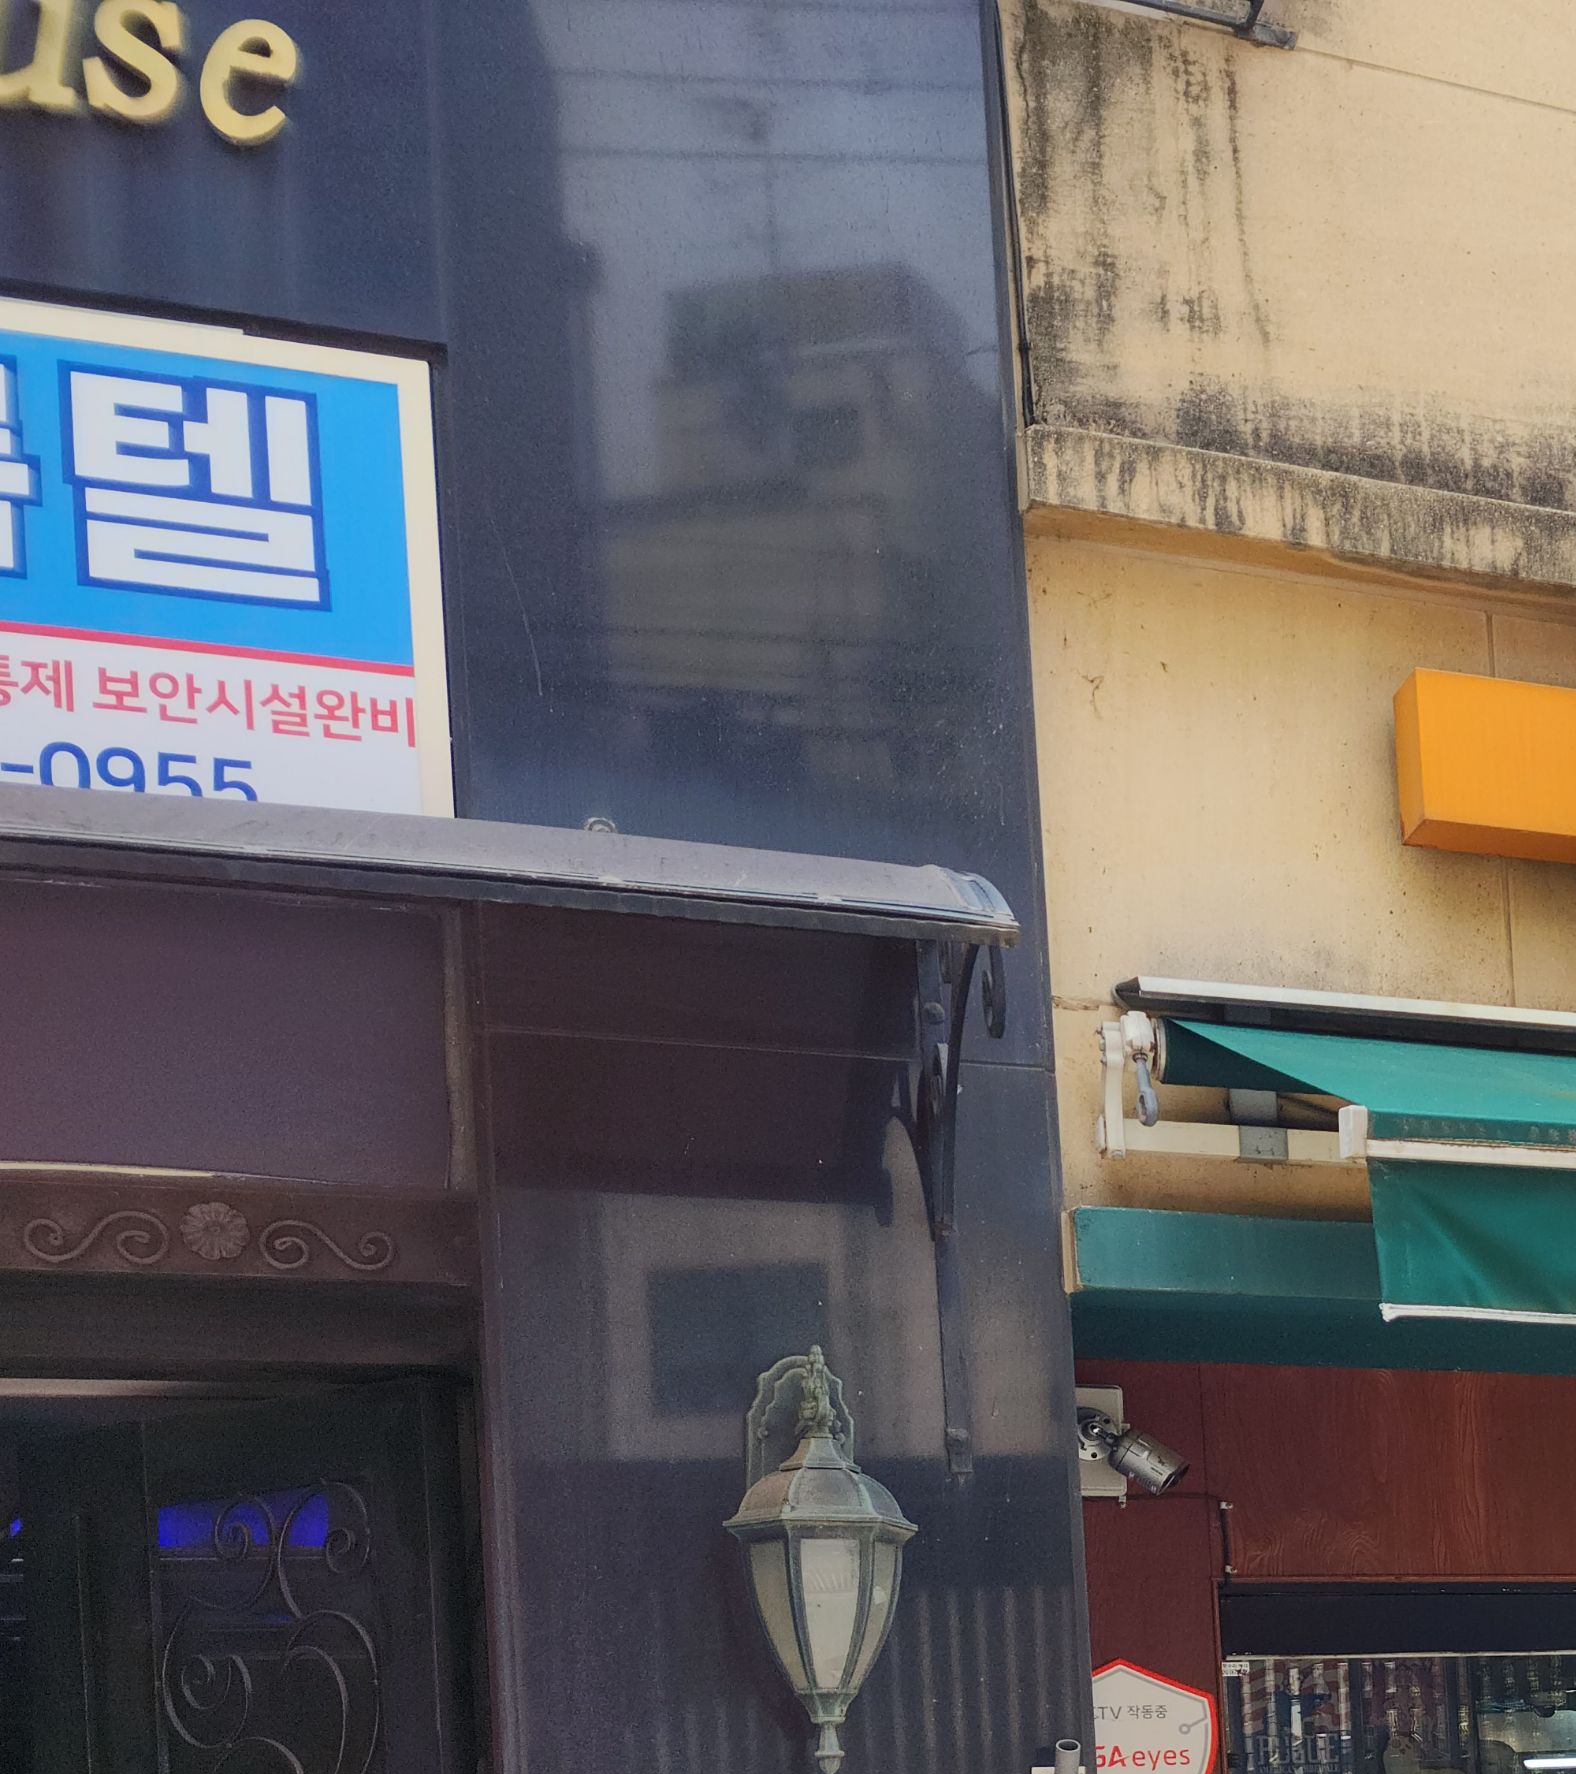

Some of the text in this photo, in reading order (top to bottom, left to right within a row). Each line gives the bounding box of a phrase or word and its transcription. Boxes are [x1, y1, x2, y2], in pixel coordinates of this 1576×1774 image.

[92, 666, 417, 748] 보안시설완비
[1127, 1704, 1168, 1720] 작동중
[1131, 1748, 1191, 1772] eyes
